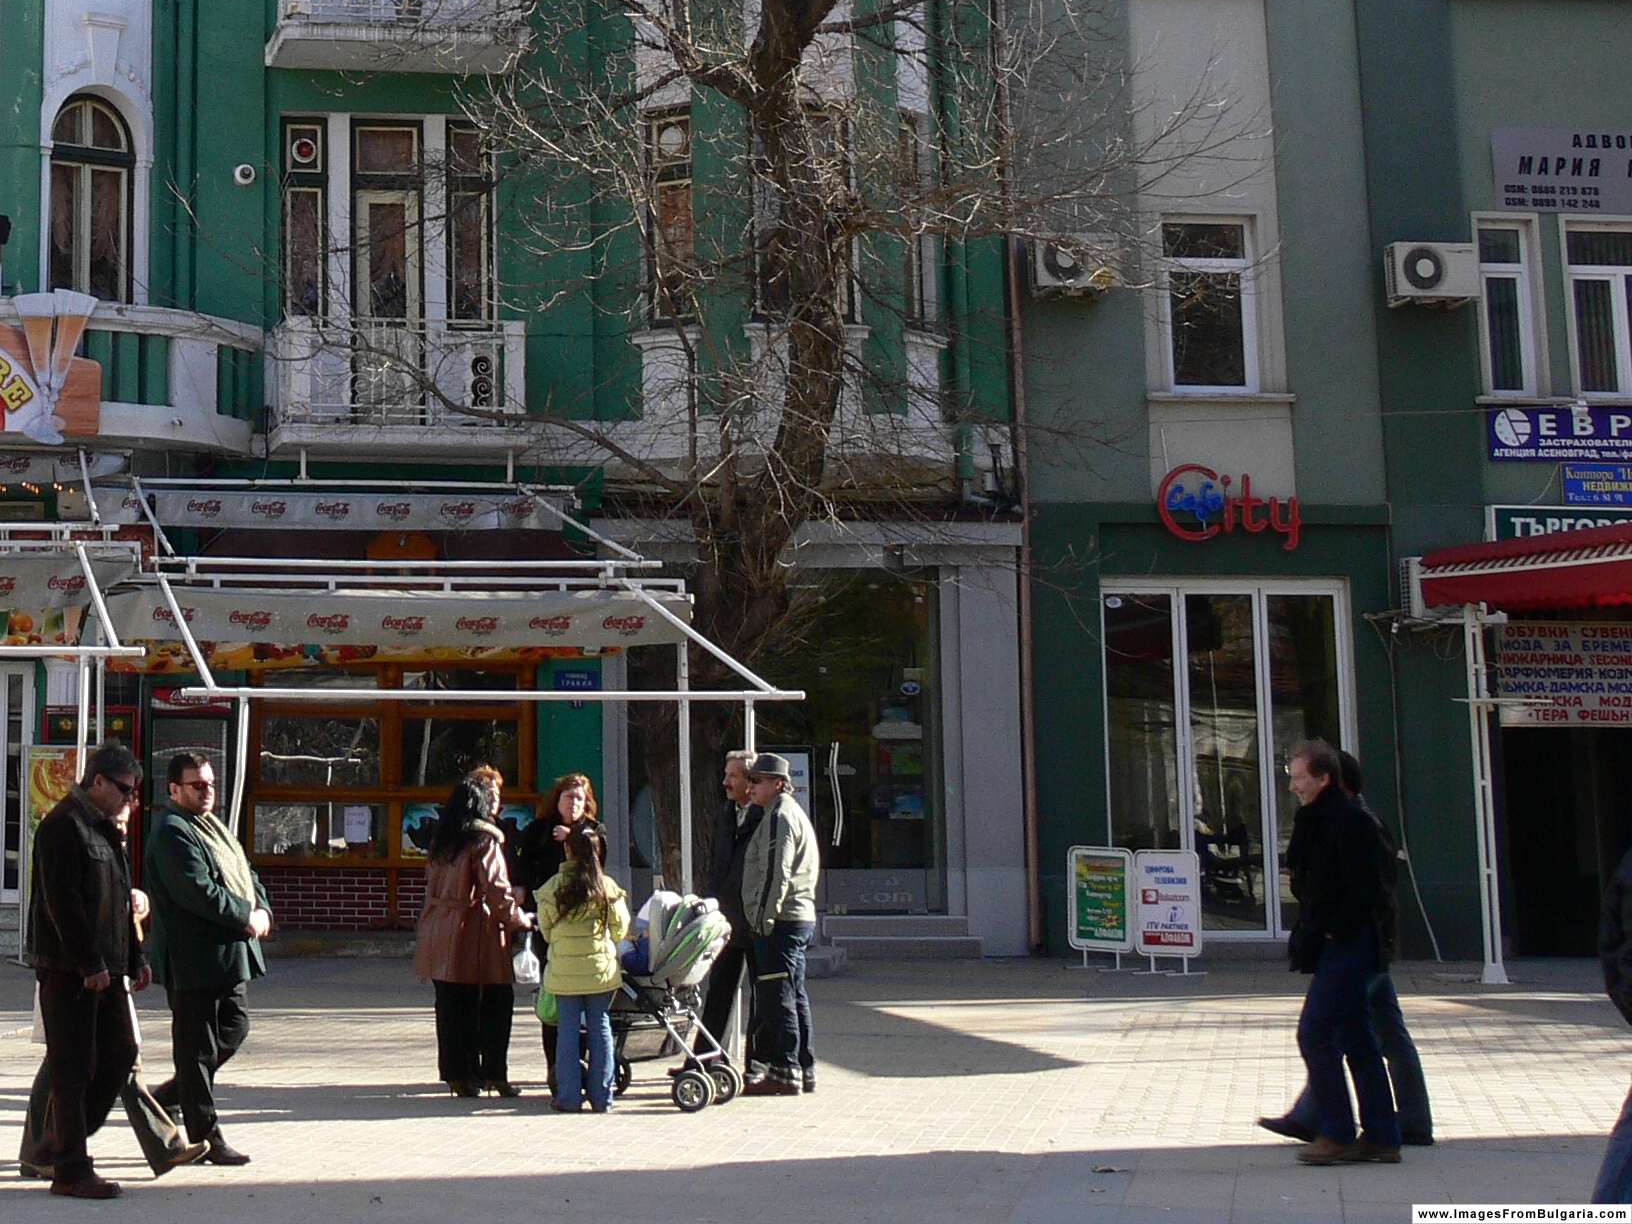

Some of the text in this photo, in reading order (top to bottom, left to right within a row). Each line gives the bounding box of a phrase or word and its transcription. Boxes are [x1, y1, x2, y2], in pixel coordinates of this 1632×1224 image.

[1572, 134, 1632, 148] АДВО
[1519, 156, 1600, 176] МАРИЯ
[1504, 184, 1528, 194] GSM:
[1559, 186, 1578, 195] 219
[1504, 197, 1528, 207] GSM:
[1493, 448, 1536, 458] АГЕНЦИЯ
[1157, 463, 1302, 551] City
[228, 609, 273, 625] Coca-Cola
[306, 612, 351, 629] Coca-Cola
[381, 614, 426, 631] Coca-Cola
[455, 615, 500, 631] Coca-Cola
[528, 615, 572, 630] Coca-Cola
[602, 614, 646, 630] Coca-Cola
[1505, 626, 1568, 637] ОБУВКИ
[1554, 640, 1572, 652] ЗА
[1533, 709, 1629, 722] ТЕРА ФЕШЪН
